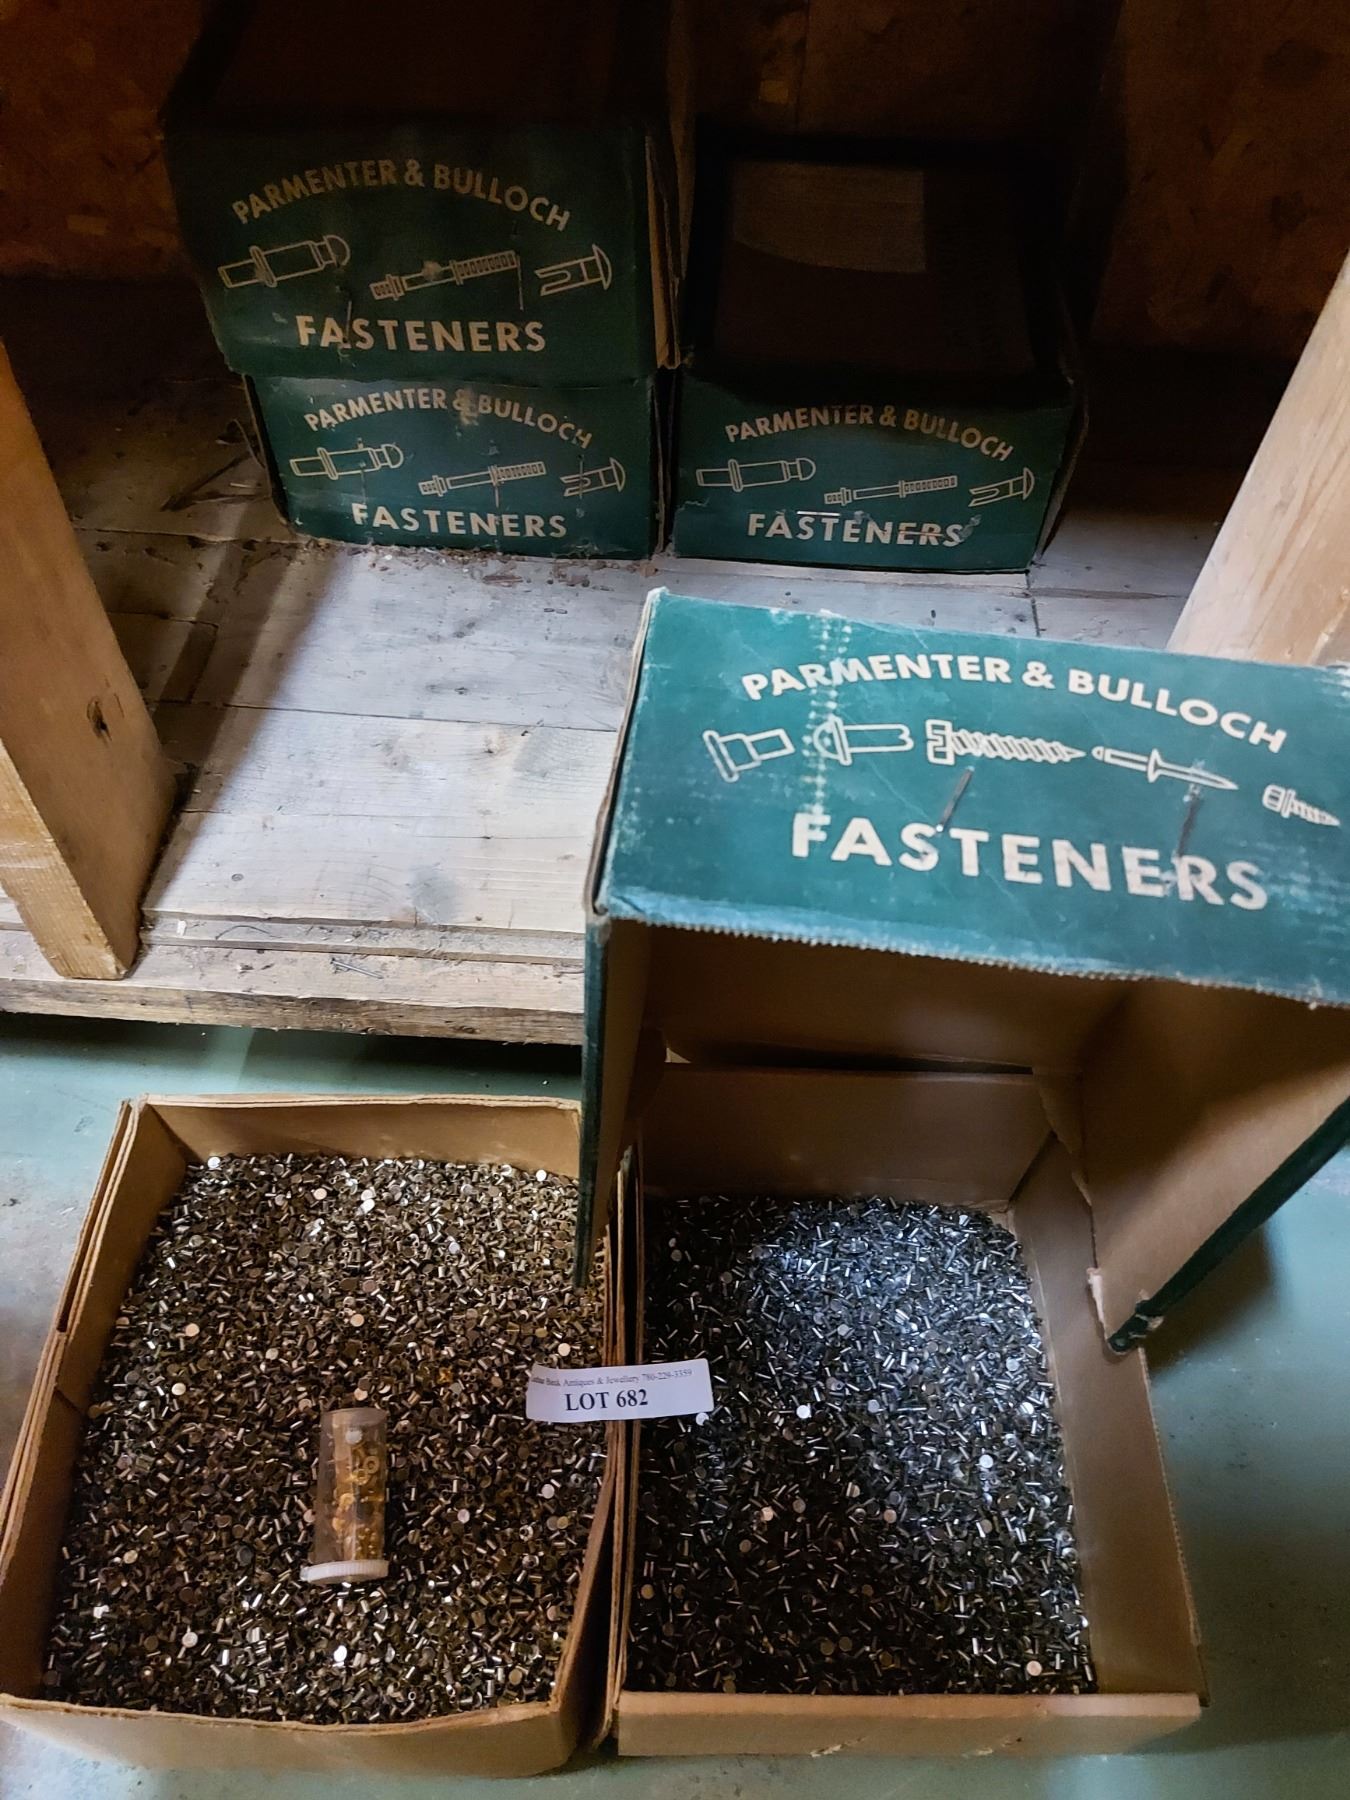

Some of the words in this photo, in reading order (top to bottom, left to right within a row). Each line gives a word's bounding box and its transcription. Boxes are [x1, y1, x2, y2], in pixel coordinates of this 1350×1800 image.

[231, 158, 398, 225] PARMENTER
[404, 157, 426, 188] &
[434, 163, 571, 232] BULLOCH
[296, 314, 547, 353] FASTENERS
[304, 388, 448, 432] PARMENTER
[453, 389, 477, 414] &
[477, 392, 594, 449] BULLOCH
[725, 404, 874, 443] PARMENTER
[878, 405, 897, 428] &
[903, 408, 1014, 462] BULLOCH
[352, 502, 568, 539] FASTENERS
[747, 512, 966, 548] FASTENERS
[742, 652, 1011, 701] PARMENTER
[1021, 661, 1056, 690] &
[1068, 667, 1288, 755] BULLOCH
[792, 811, 1269, 912] FASTENERS
[563, 1378, 594, 1388] Antiques
[596, 1376, 604, 1385] &
[564, 1391, 610, 1412] LOT
[616, 1388, 649, 1408] 682
